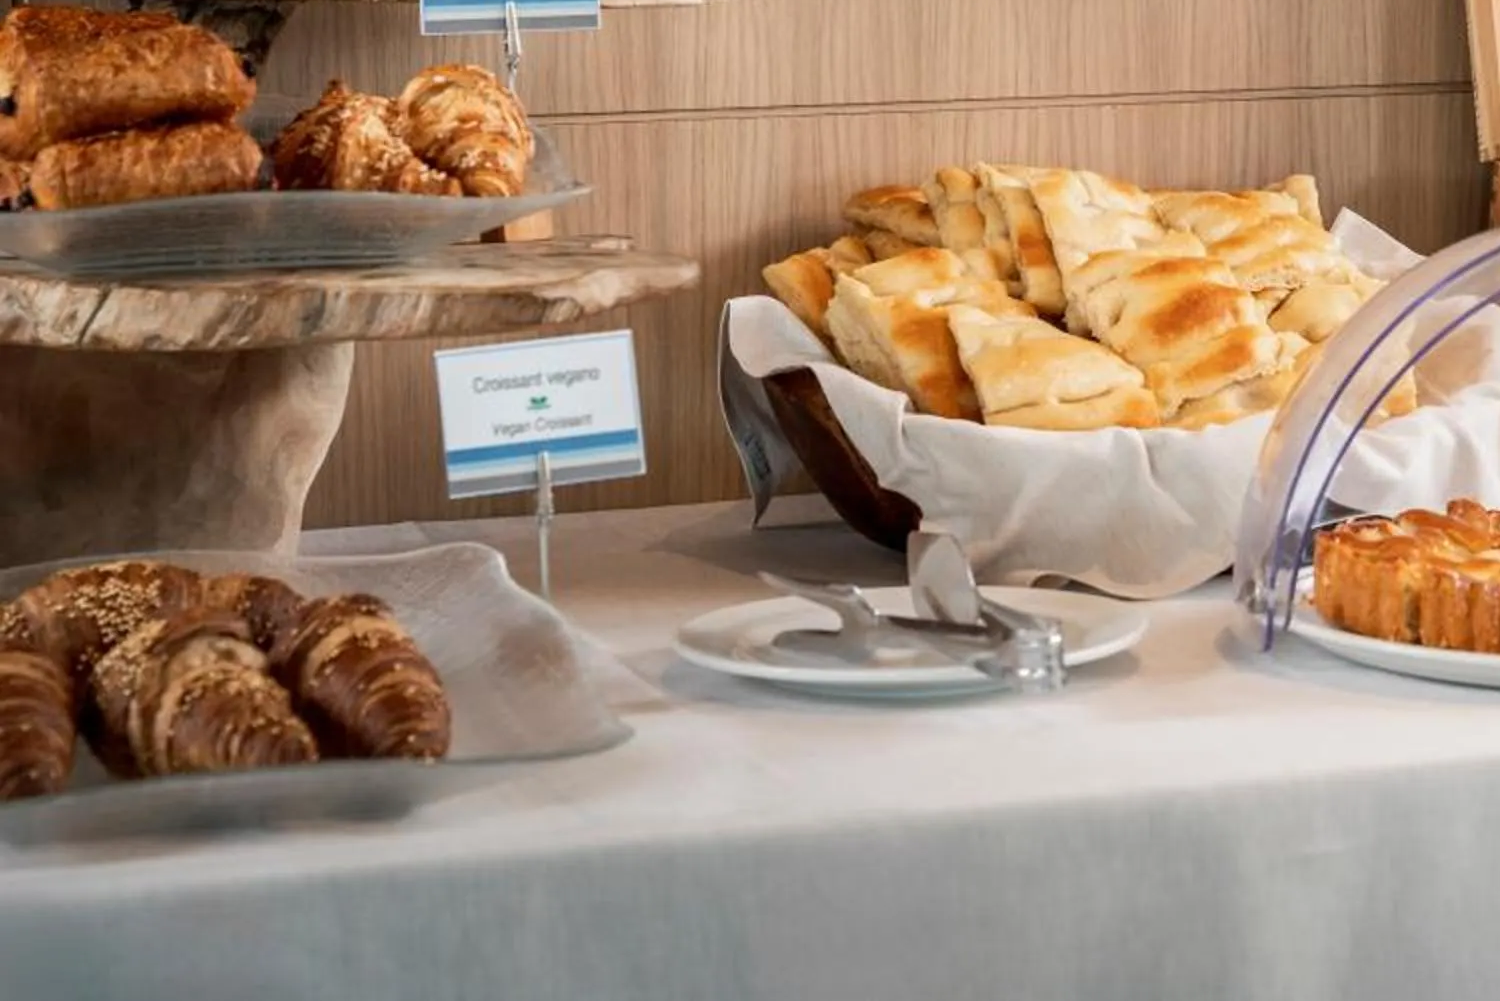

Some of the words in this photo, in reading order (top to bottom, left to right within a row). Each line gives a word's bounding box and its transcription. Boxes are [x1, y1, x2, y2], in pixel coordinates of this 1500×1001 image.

[473, 372, 543, 394] Croissant
[547, 366, 600, 388] vegano
[492, 420, 531, 437] Vegan
[534, 414, 593, 432] Croissant
